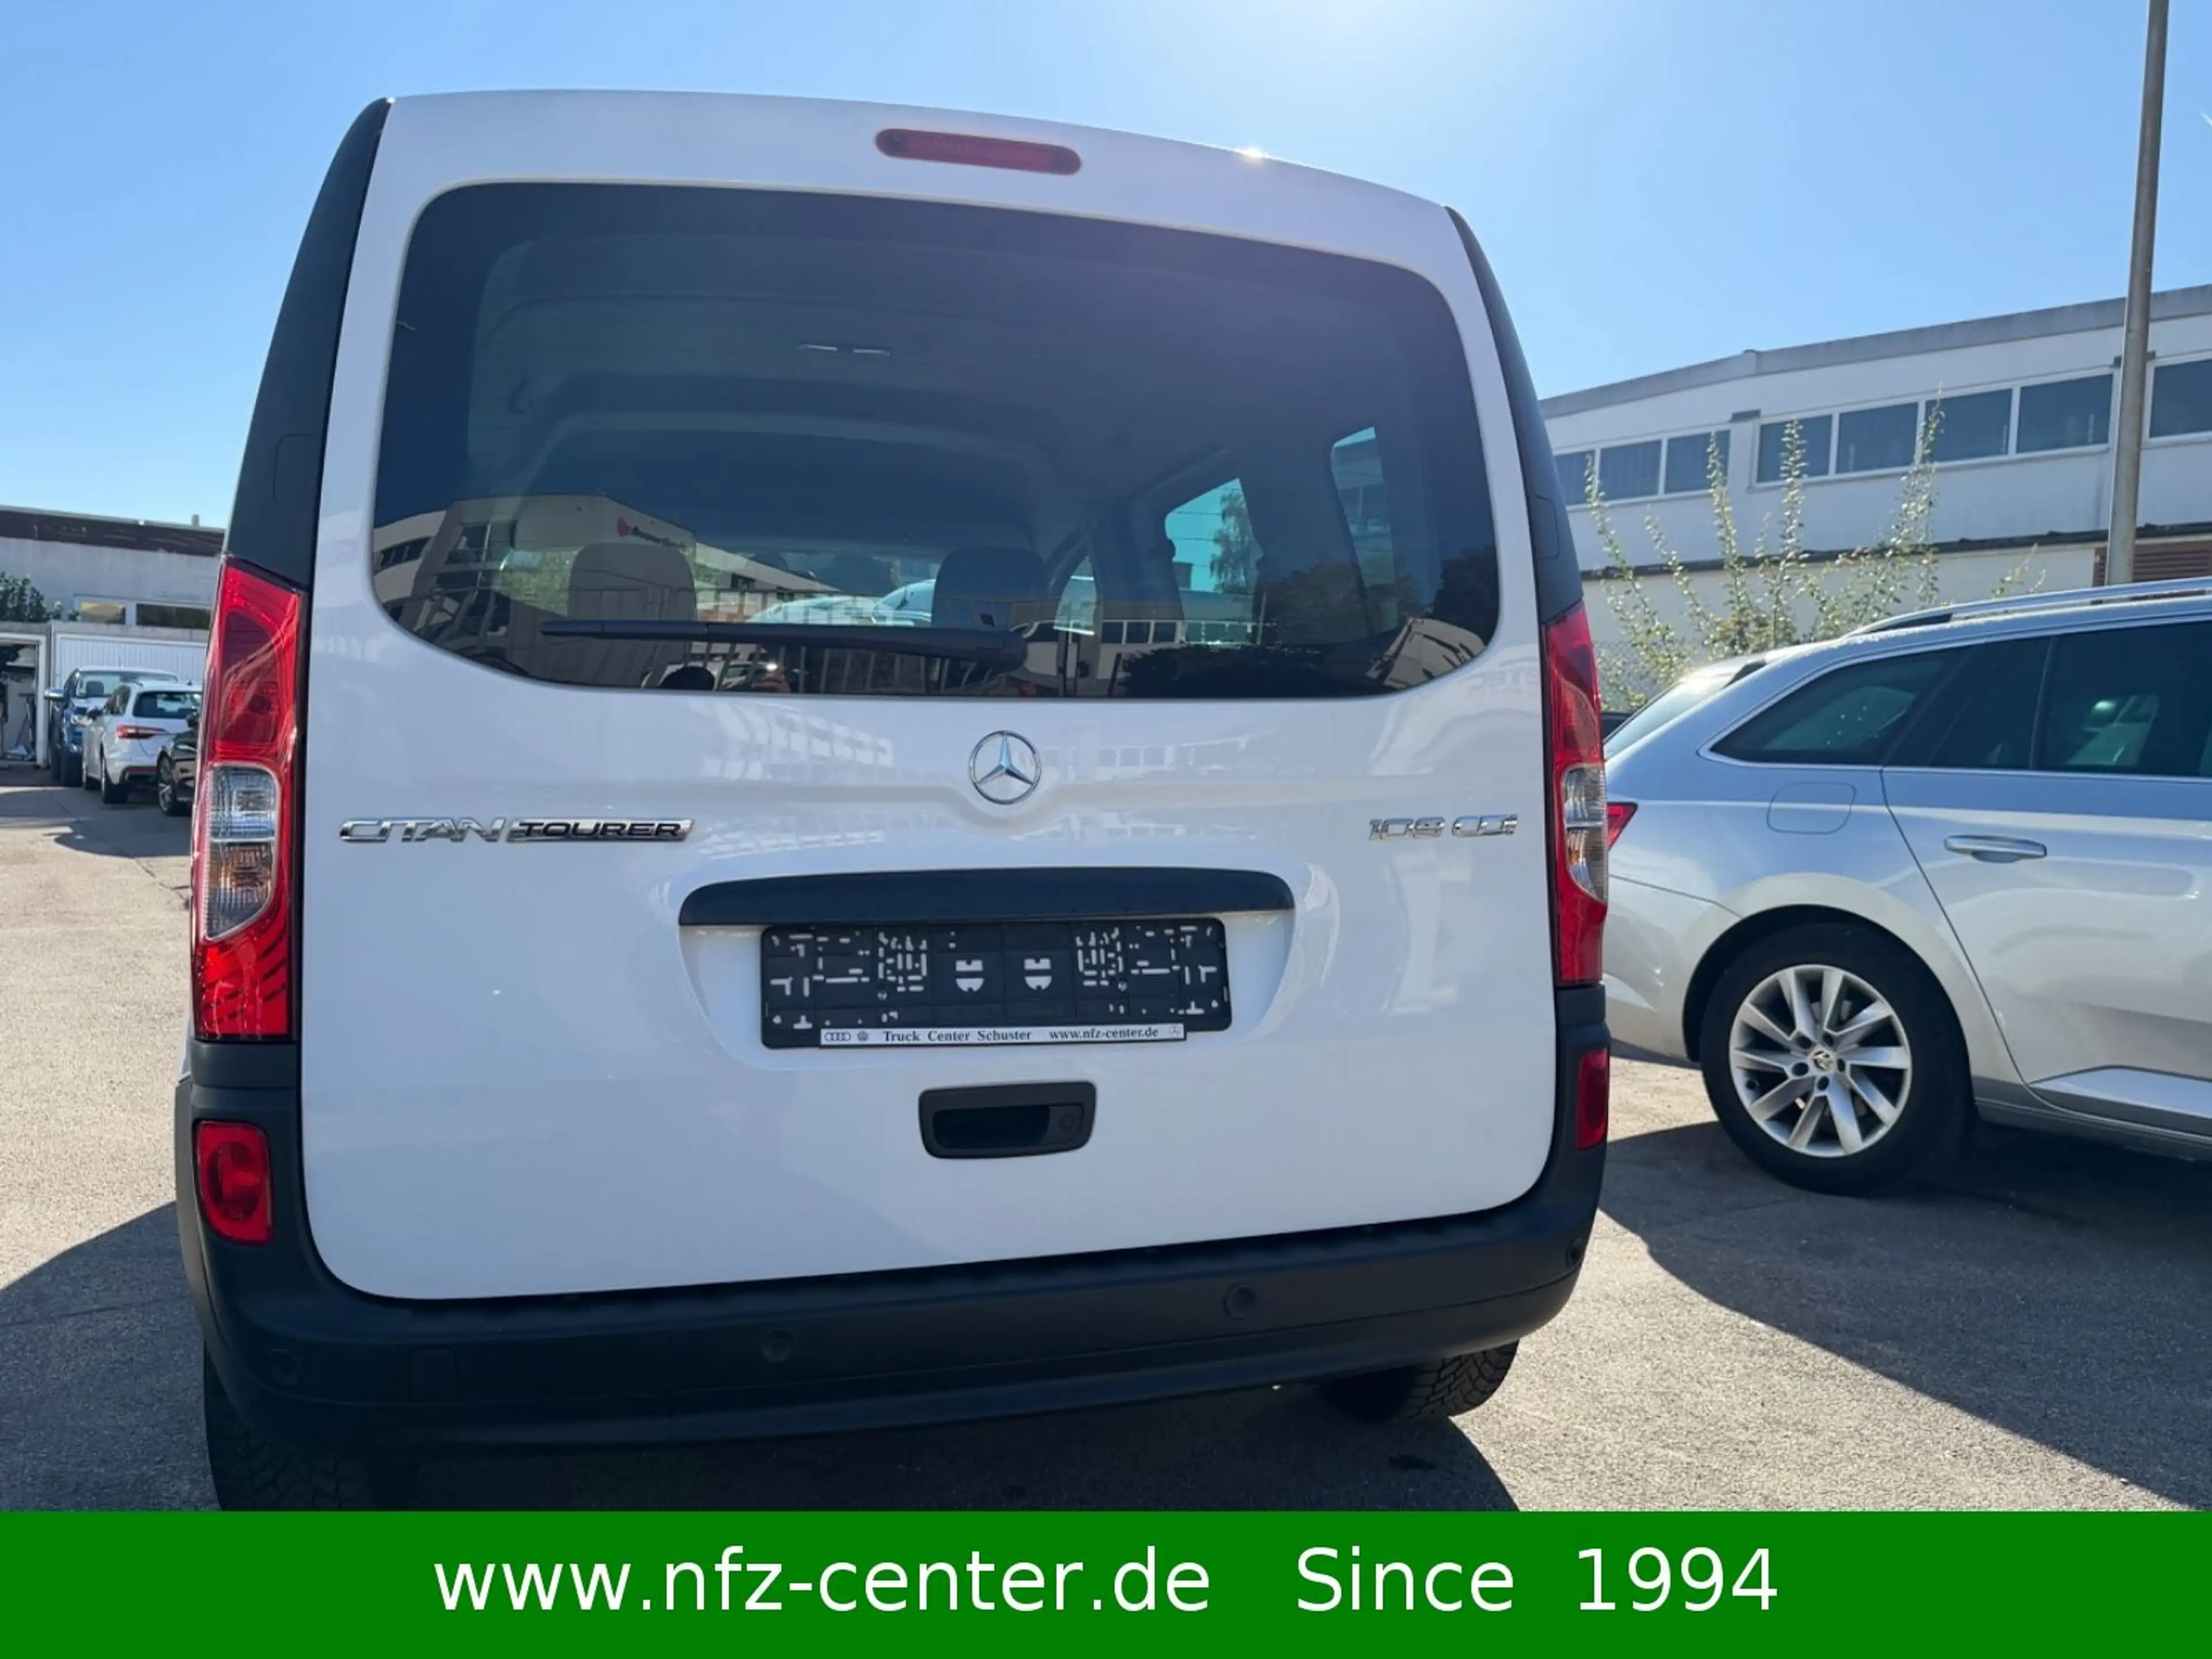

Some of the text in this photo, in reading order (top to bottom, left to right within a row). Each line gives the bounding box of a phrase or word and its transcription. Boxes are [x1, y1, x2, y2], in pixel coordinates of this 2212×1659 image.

[339, 817, 687, 843] CITAN TOURER
[1369, 816, 1445, 840] 108
[884, 1027, 1160, 1042] Truck Center Schuster www.nfz-center.de
